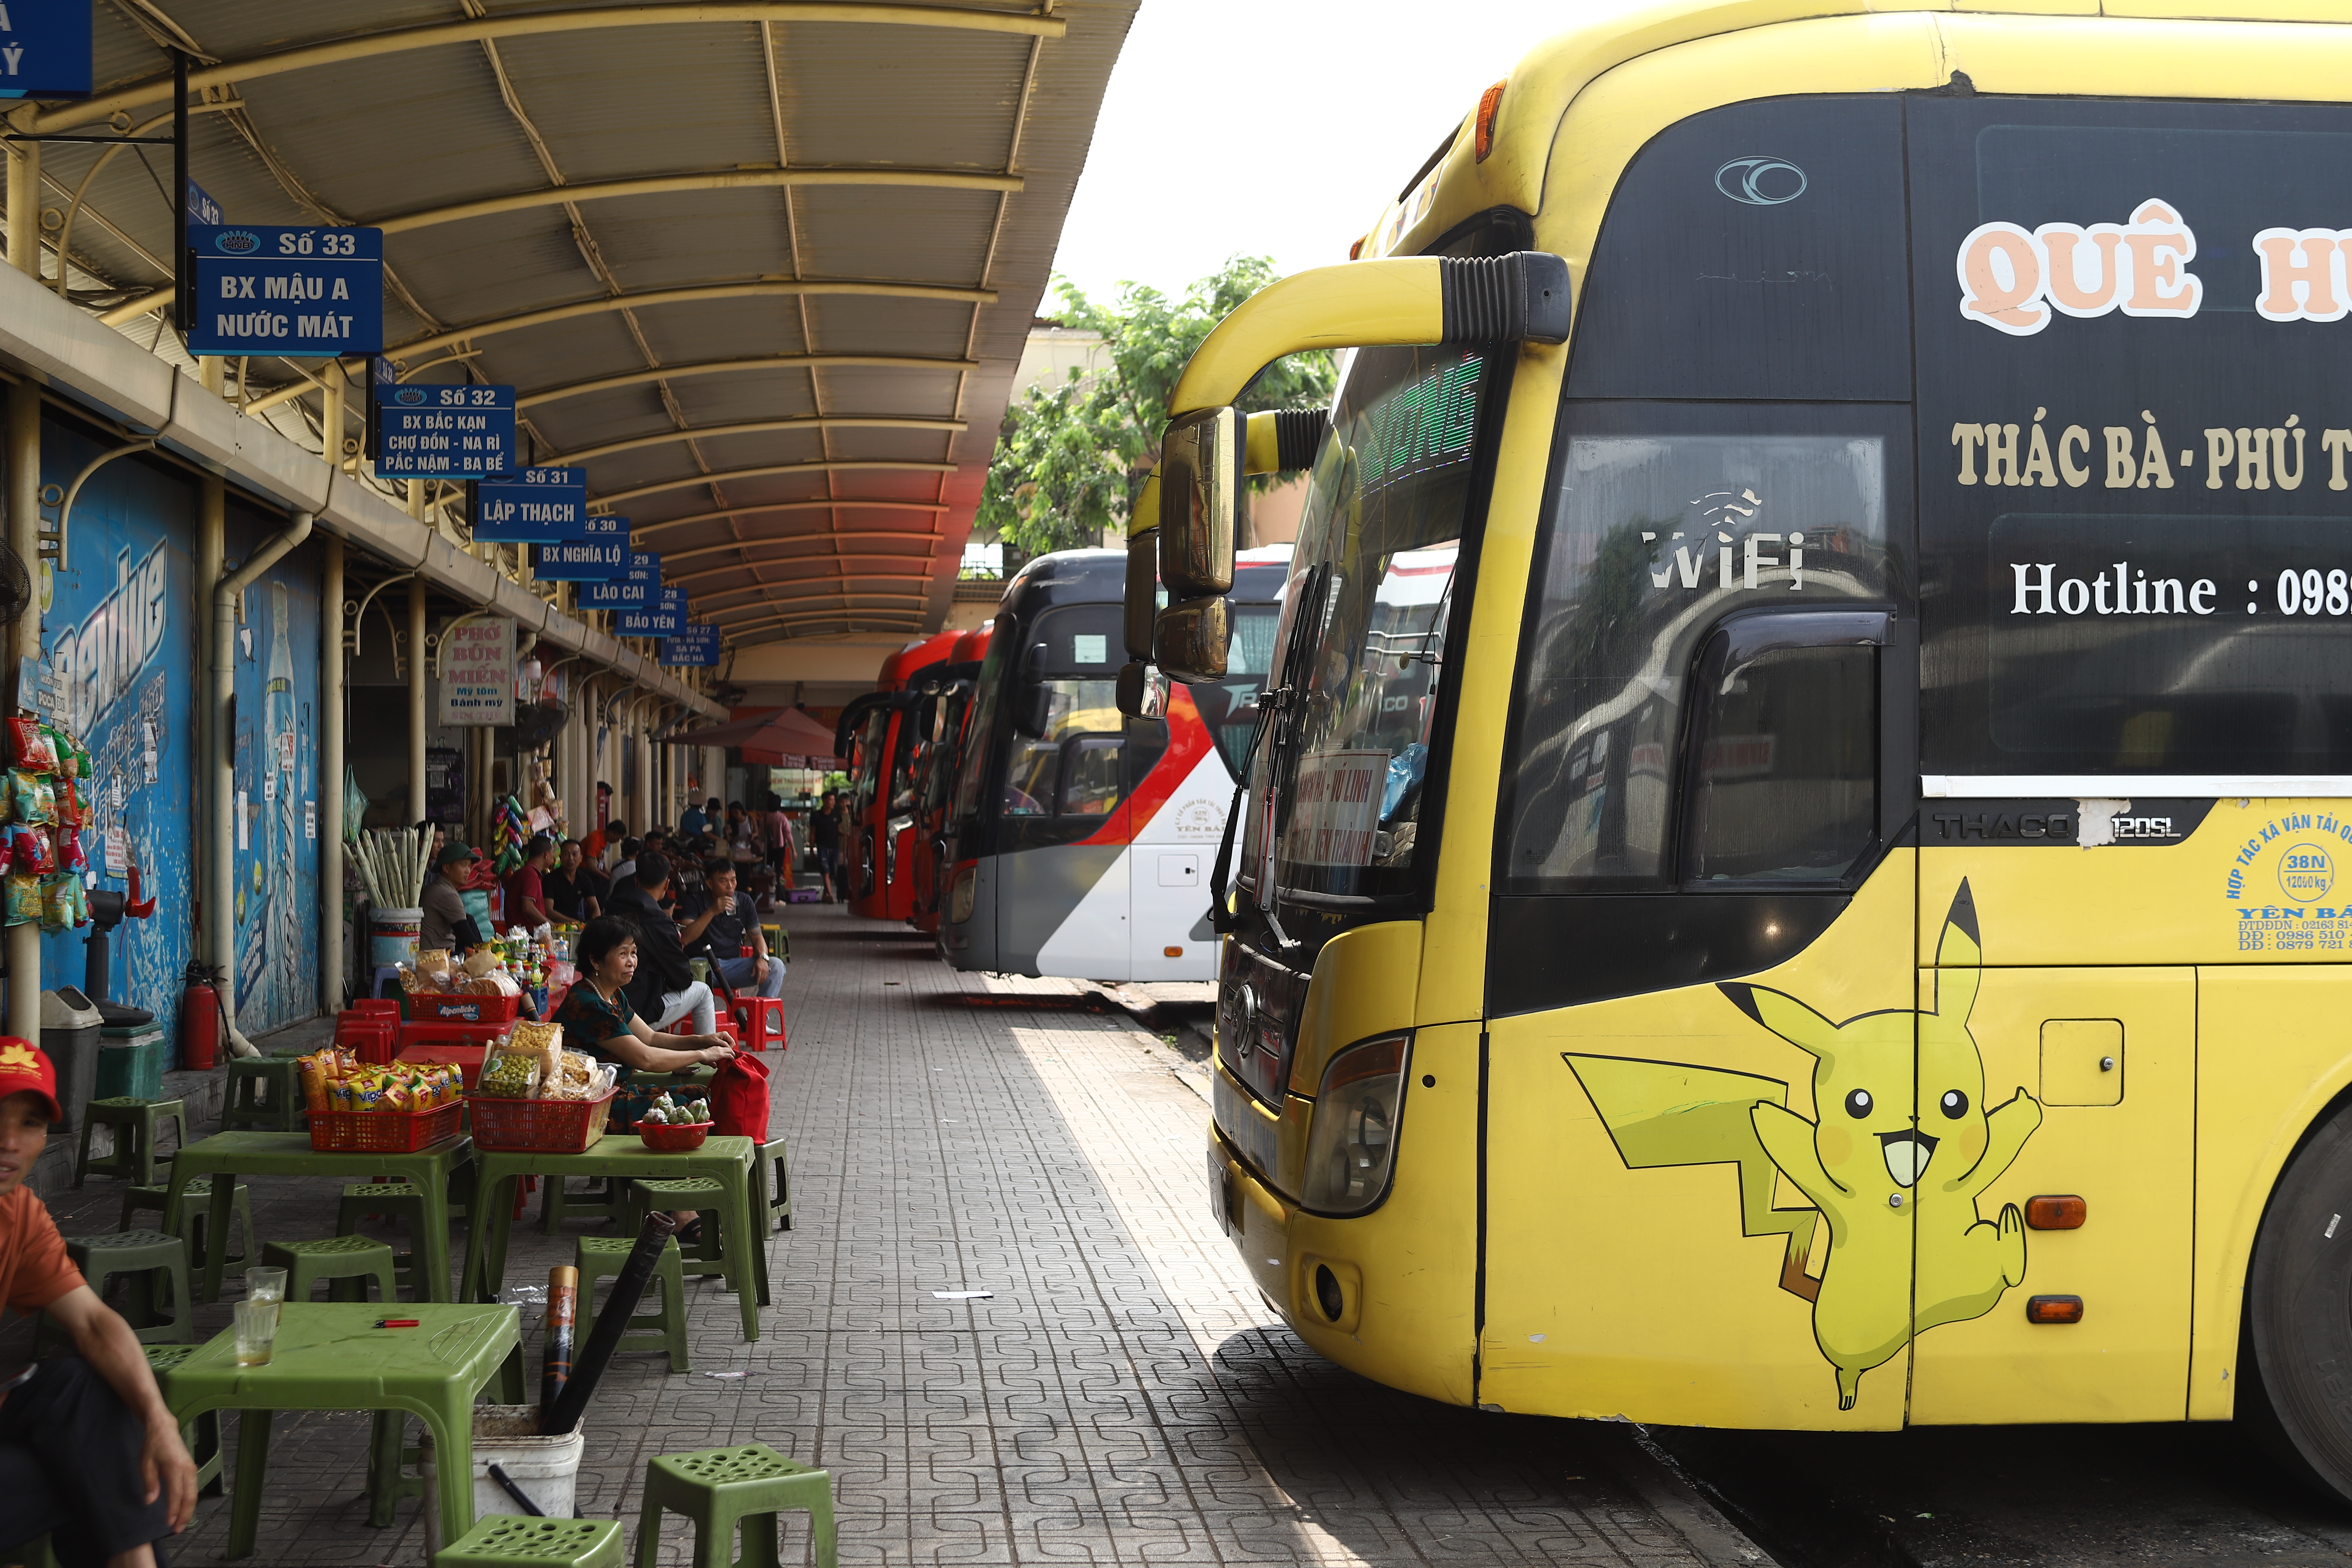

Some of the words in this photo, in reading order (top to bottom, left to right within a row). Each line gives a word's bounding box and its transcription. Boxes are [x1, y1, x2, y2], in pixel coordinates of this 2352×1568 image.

[0, 42, 24, 75] Ý
[202, 197, 211, 222] Số
[211, 205, 219, 225] 33
[279, 230, 316, 255] Số
[322, 234, 356, 256] 33
[1956, 198, 2203, 336] QUÊ
[2252, 227, 2352, 322] H
[221, 276, 256, 299] BX
[265, 272, 323, 305] MẬU
[331, 278, 349, 300] A
[217, 310, 289, 338] NƯỚC
[297, 311, 354, 338] MÁT
[440, 387, 467, 406] Số
[471, 390, 496, 406] 32
[403, 415, 421, 429] BX
[425, 410, 453, 430] BẮC
[457, 415, 486, 433] KẠN
[388, 434, 417, 453] CHỢ
[463, 436, 482, 450] NA
[1951, 407, 2091, 488] THÁC
[2103, 410, 2174, 489] BÀ
[2203, 414, 2306, 490] PHÚ
[385, 451, 413, 470] PẮC
[417, 453, 450, 473] NẬM
[463, 456, 482, 471] BA
[486, 451, 504, 471] BỂ
[525, 469, 547, 484] Số
[551, 471, 568, 484] 31
[484, 499, 516, 525] LẬP
[521, 503, 574, 525] THẠCH
[600, 520, 617, 531] 30
[543, 546, 560, 562] BX
[563, 544, 602, 563] NGHĨA
[605, 544, 621, 566] LỘ
[634, 555, 648, 565] 29
[593, 583, 618, 600] LÀO
[622, 585, 644, 600] CAI
[665, 590, 677, 599] 28
[2010, 562, 2216, 615] Hotline
[2277, 569, 2352, 616] 098
[453, 620, 501, 641] PHỞ
[625, 612, 649, 628] BẢO
[652, 614, 675, 629] YÊN
[38, 691, 55, 709] POCA
[1330, 761, 1348, 802] VŨ
[1343, 769, 1373, 803] LINH
[1934, 813, 2074, 838] THACO
[2111, 816, 2181, 838] 120SL
[1314, 821, 1333, 861] YÊN
[1331, 821, 1370, 865] THÀNH
[2226, 868, 2245, 899] HỢP
[2236, 839, 2261, 867] TÁC
[2258, 820, 2280, 844] XÃ
[2281, 812, 2311, 833] VẬN
[2316, 812, 2339, 834] TẢI
[2287, 855, 2325, 869] 38N
[2315, 876, 2326, 891] kg
[2235, 905, 2306, 919] YÊN
[2237, 920, 2292, 930] ĐTDĐDN
[2301, 920, 2334, 930] 02163
[2237, 931, 2264, 940] DĐ
[2276, 930, 2314, 940] 0986
[2318, 930, 2344, 940] 510
[2237, 940, 2264, 950] DĐ
[2276, 940, 2314, 950] 0879
[2318, 940, 2344, 950] 721
[440, 1004, 476, 1017] Alpenliebe
